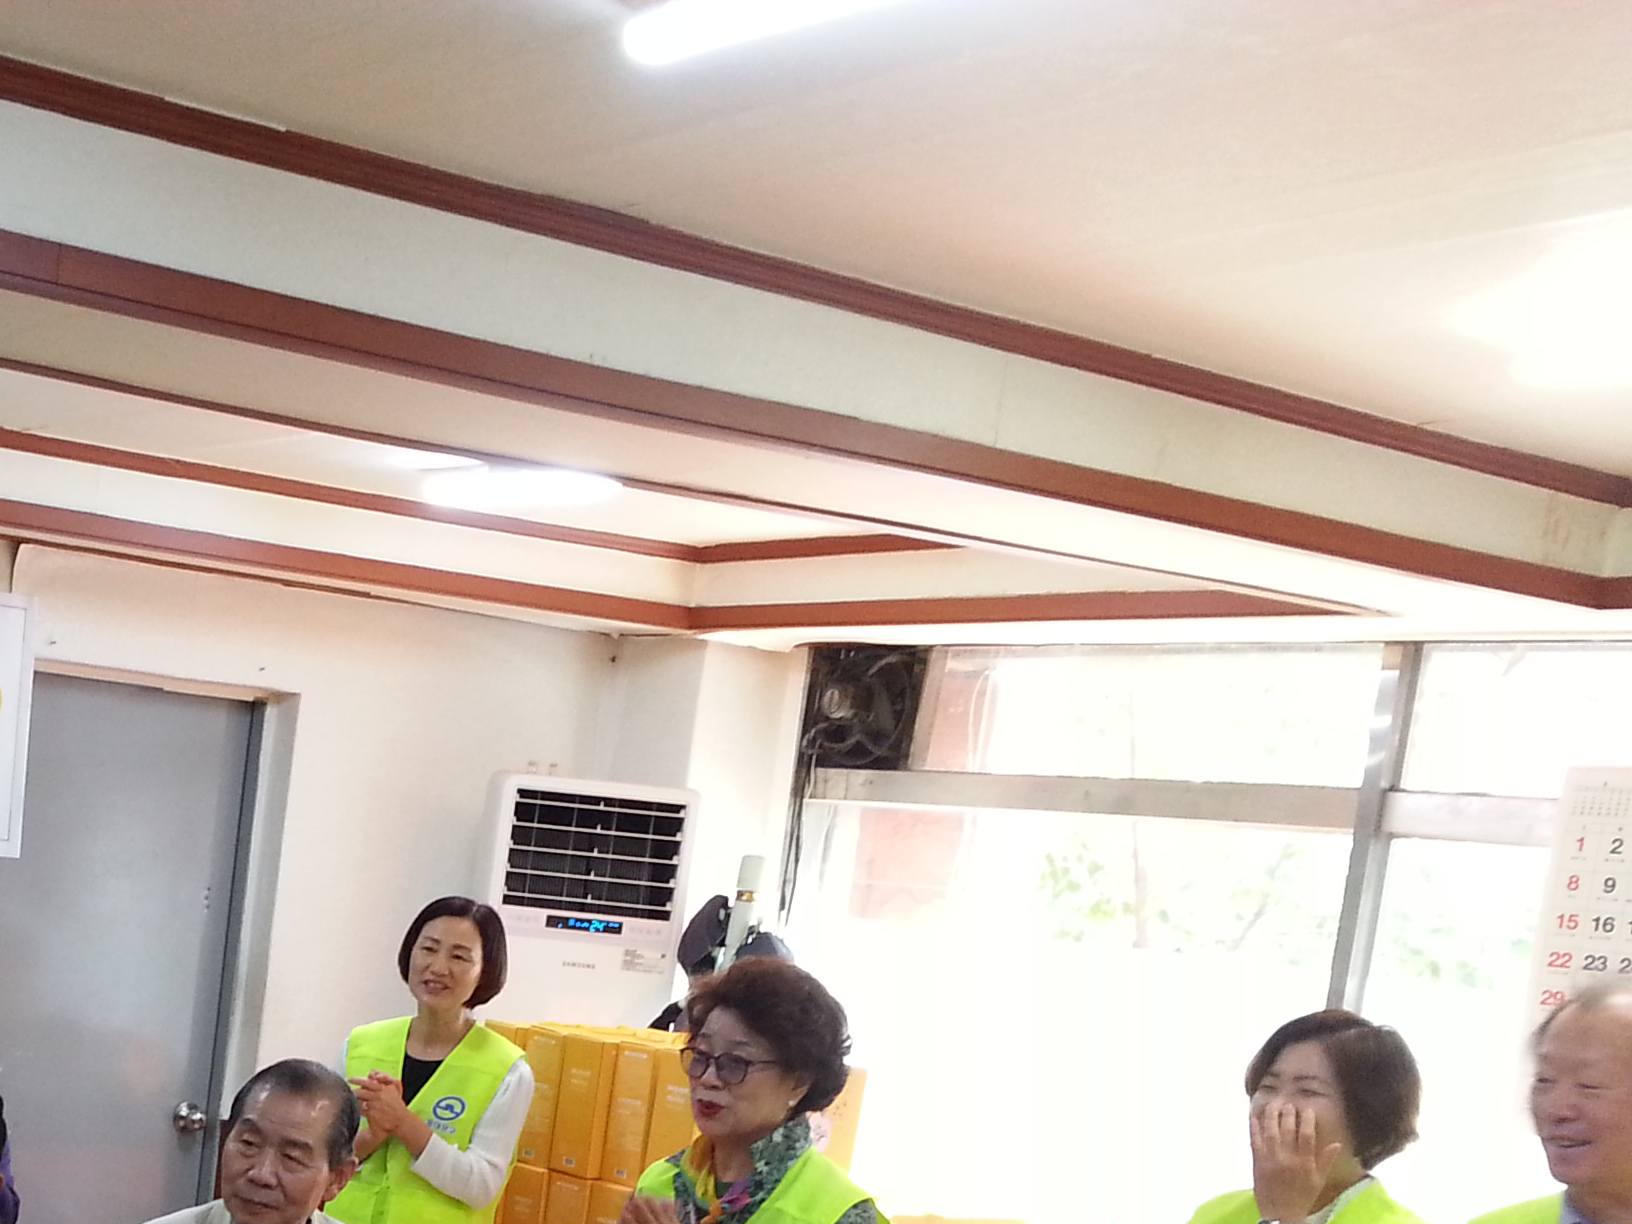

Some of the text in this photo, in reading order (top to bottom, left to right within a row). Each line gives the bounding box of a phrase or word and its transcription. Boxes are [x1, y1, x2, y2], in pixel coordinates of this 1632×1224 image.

[1576, 836, 1625, 855] 1 2
[1566, 874, 1617, 894] 8 9
[1556, 913, 1616, 934] 15 16
[1546, 951, 1573, 969] 22
[1582, 954, 1609, 972] 23
